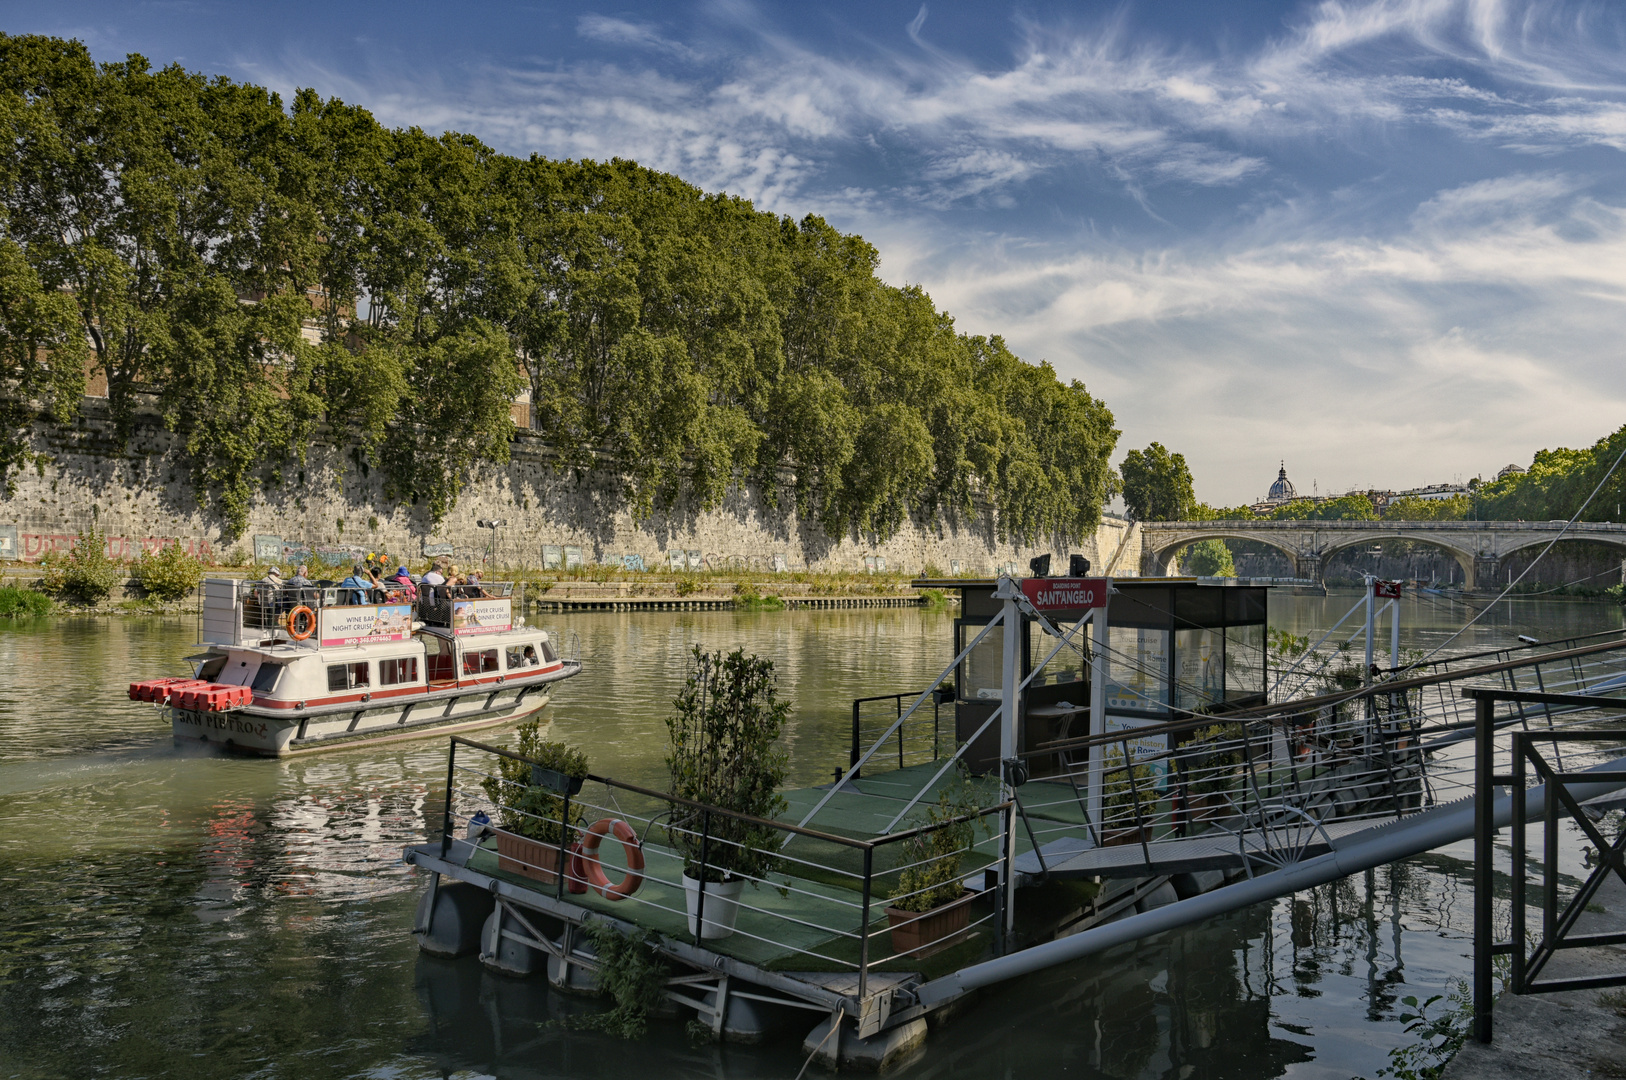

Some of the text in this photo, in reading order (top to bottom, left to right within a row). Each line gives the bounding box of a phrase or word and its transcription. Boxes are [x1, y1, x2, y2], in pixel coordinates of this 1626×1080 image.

[1036, 589, 1094, 606] SANT'ANGELO
[344, 637, 359, 645] INFO:
[179, 711, 254, 733] SAN PIETRO
[1140, 738, 1166, 750] history
